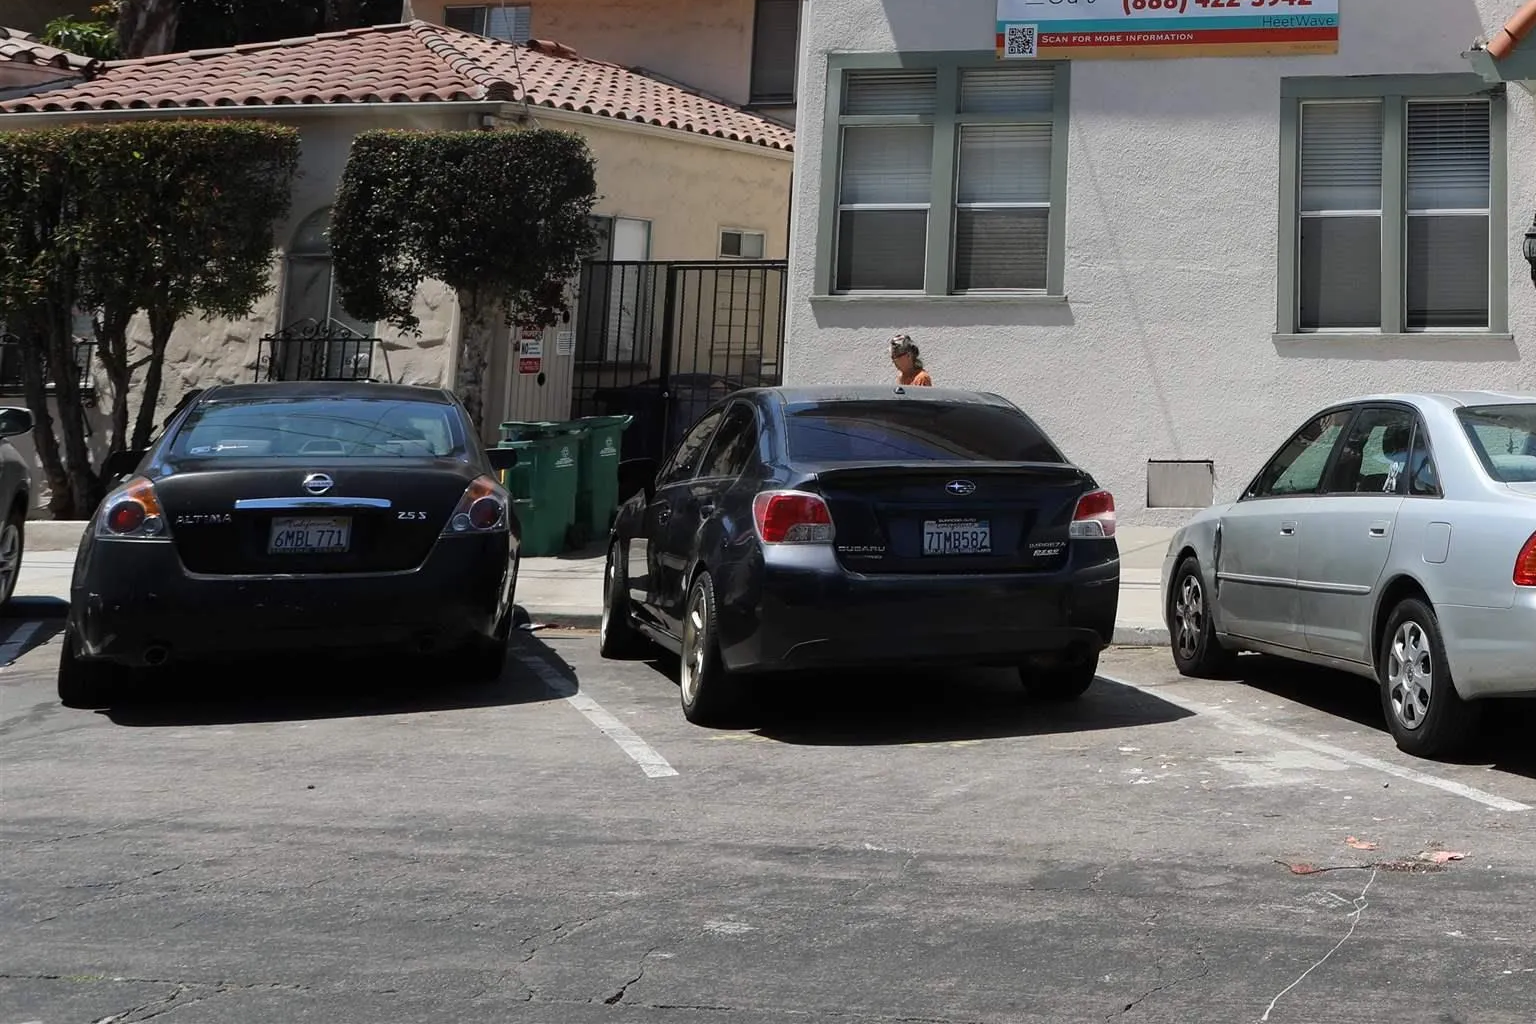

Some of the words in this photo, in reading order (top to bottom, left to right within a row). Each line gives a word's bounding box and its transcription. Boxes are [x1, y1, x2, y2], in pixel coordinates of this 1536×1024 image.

[1262, 14, 1335, 28] HeetWave
[1042, 34, 1069, 43] SCAN
[1072, 34, 1092, 43] FOR
[1095, 33, 1123, 42] MORE
[1126, 32, 1194, 42] INFORMATION
[176, 513, 232, 525] ALTIMA
[925, 531, 988, 551] 7TMB582
